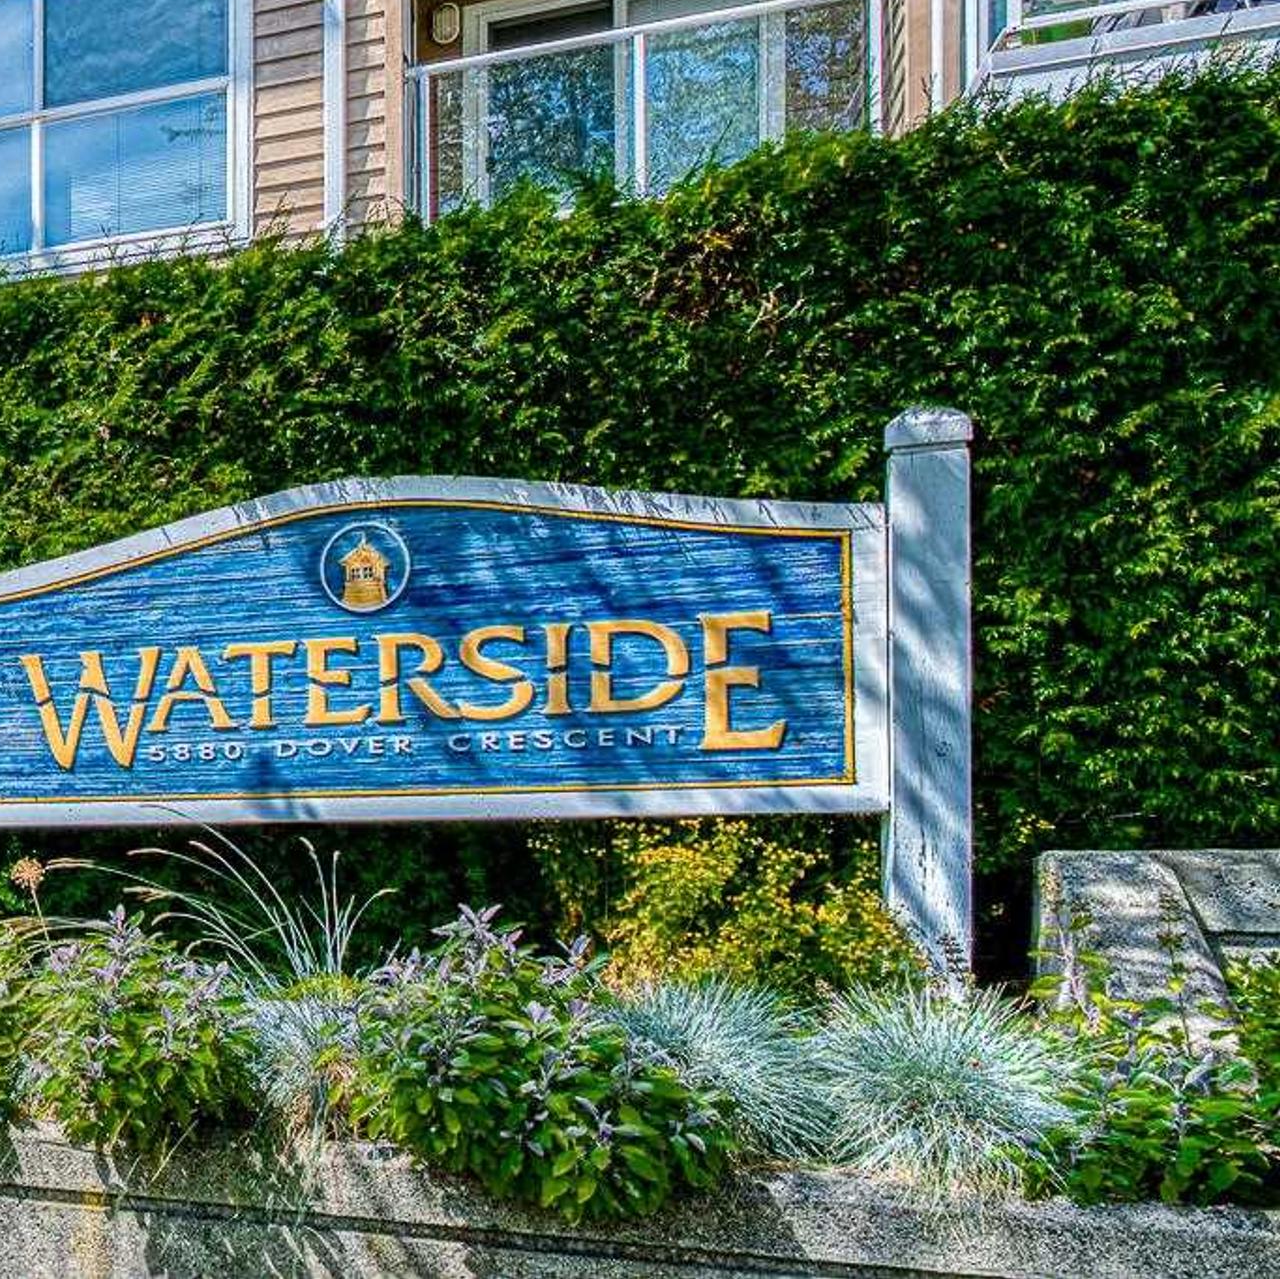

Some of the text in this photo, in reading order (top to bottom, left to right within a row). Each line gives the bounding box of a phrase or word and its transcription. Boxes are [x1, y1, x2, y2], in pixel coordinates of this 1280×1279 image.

[18, 610, 787, 771] WATERSIDE
[148, 727, 687, 763] 5880 DOVER CRESCENT
